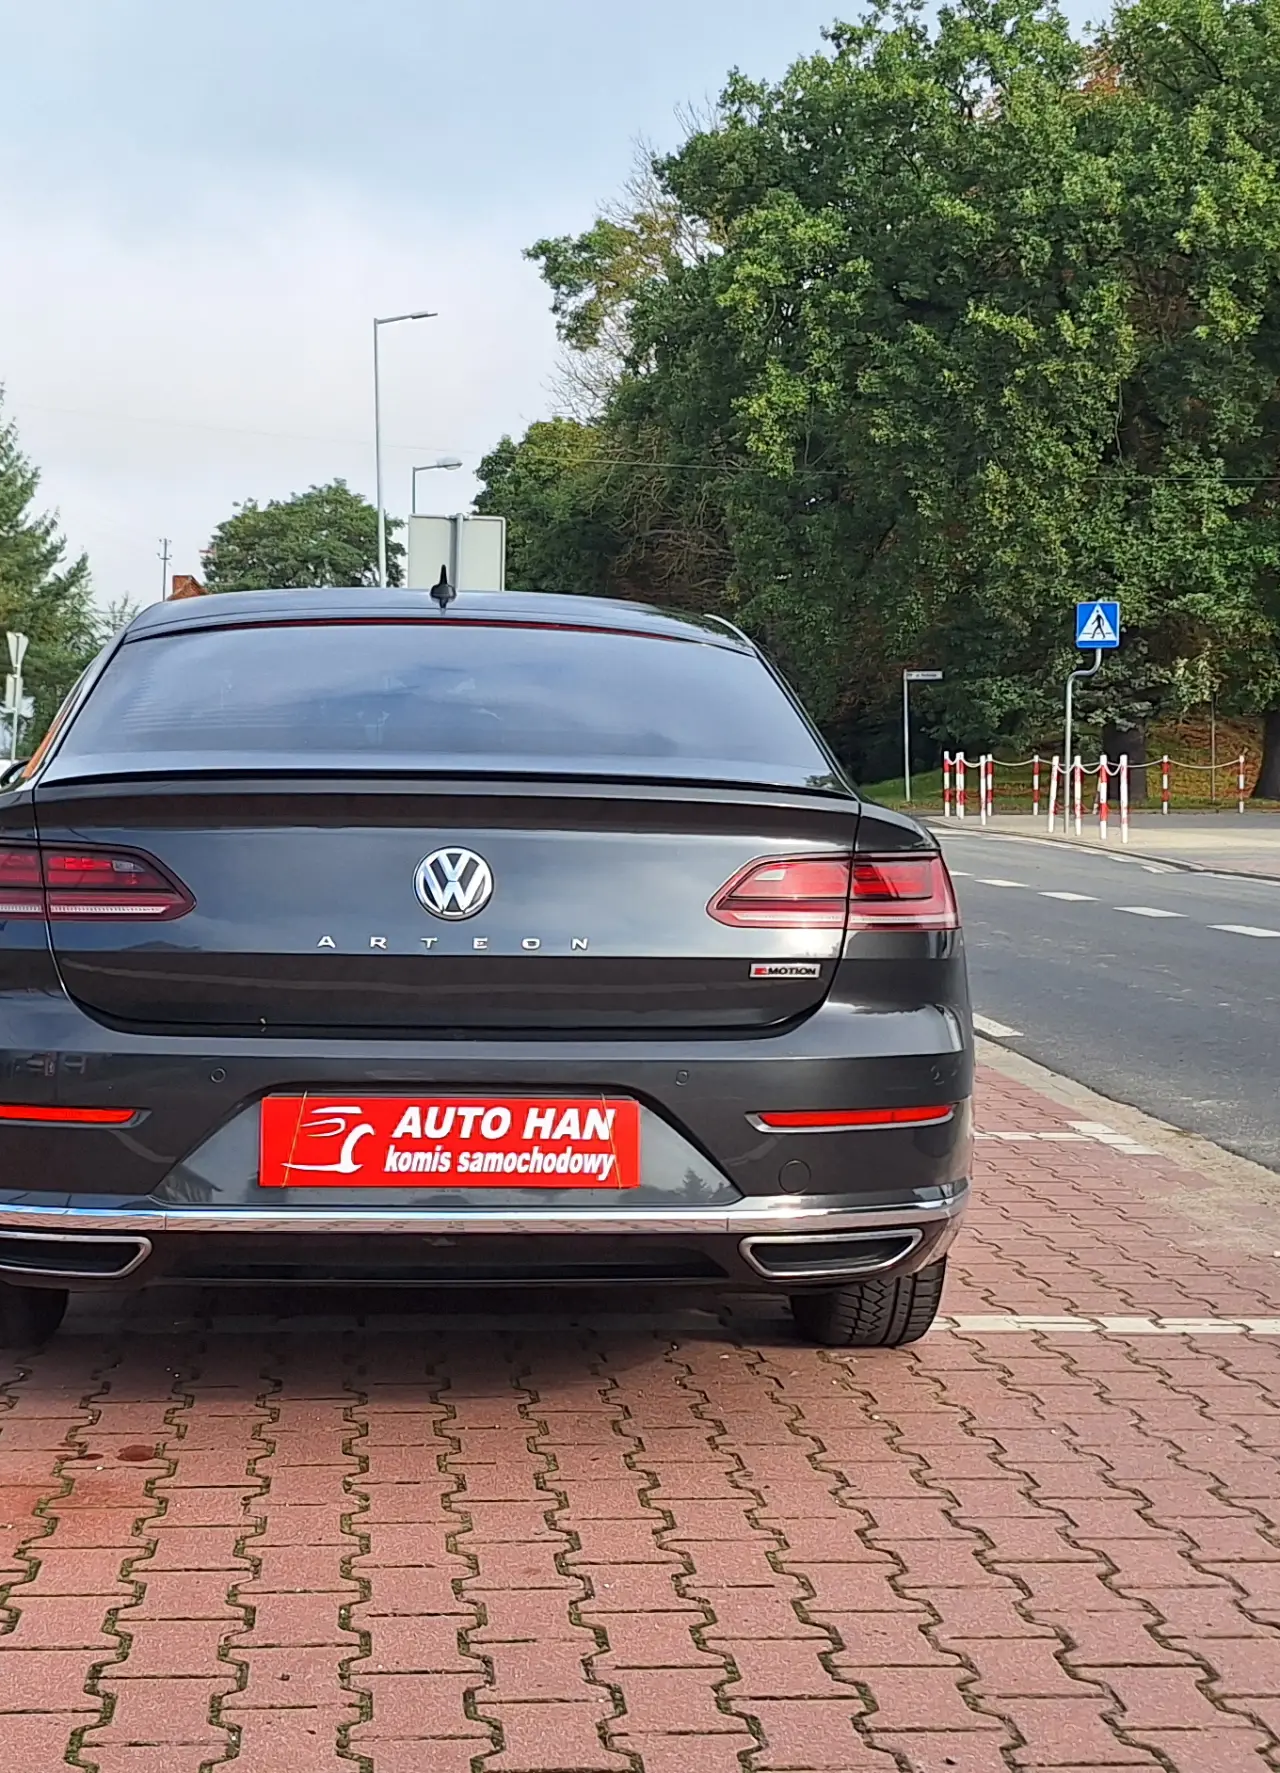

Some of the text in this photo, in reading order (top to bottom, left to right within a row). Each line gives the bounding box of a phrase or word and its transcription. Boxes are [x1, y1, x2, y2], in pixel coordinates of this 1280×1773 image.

[317, 935, 589, 951] ARTEON
[391, 1106, 616, 1141] AUTO HAN
[384, 1144, 616, 1181] komis samochodowy
